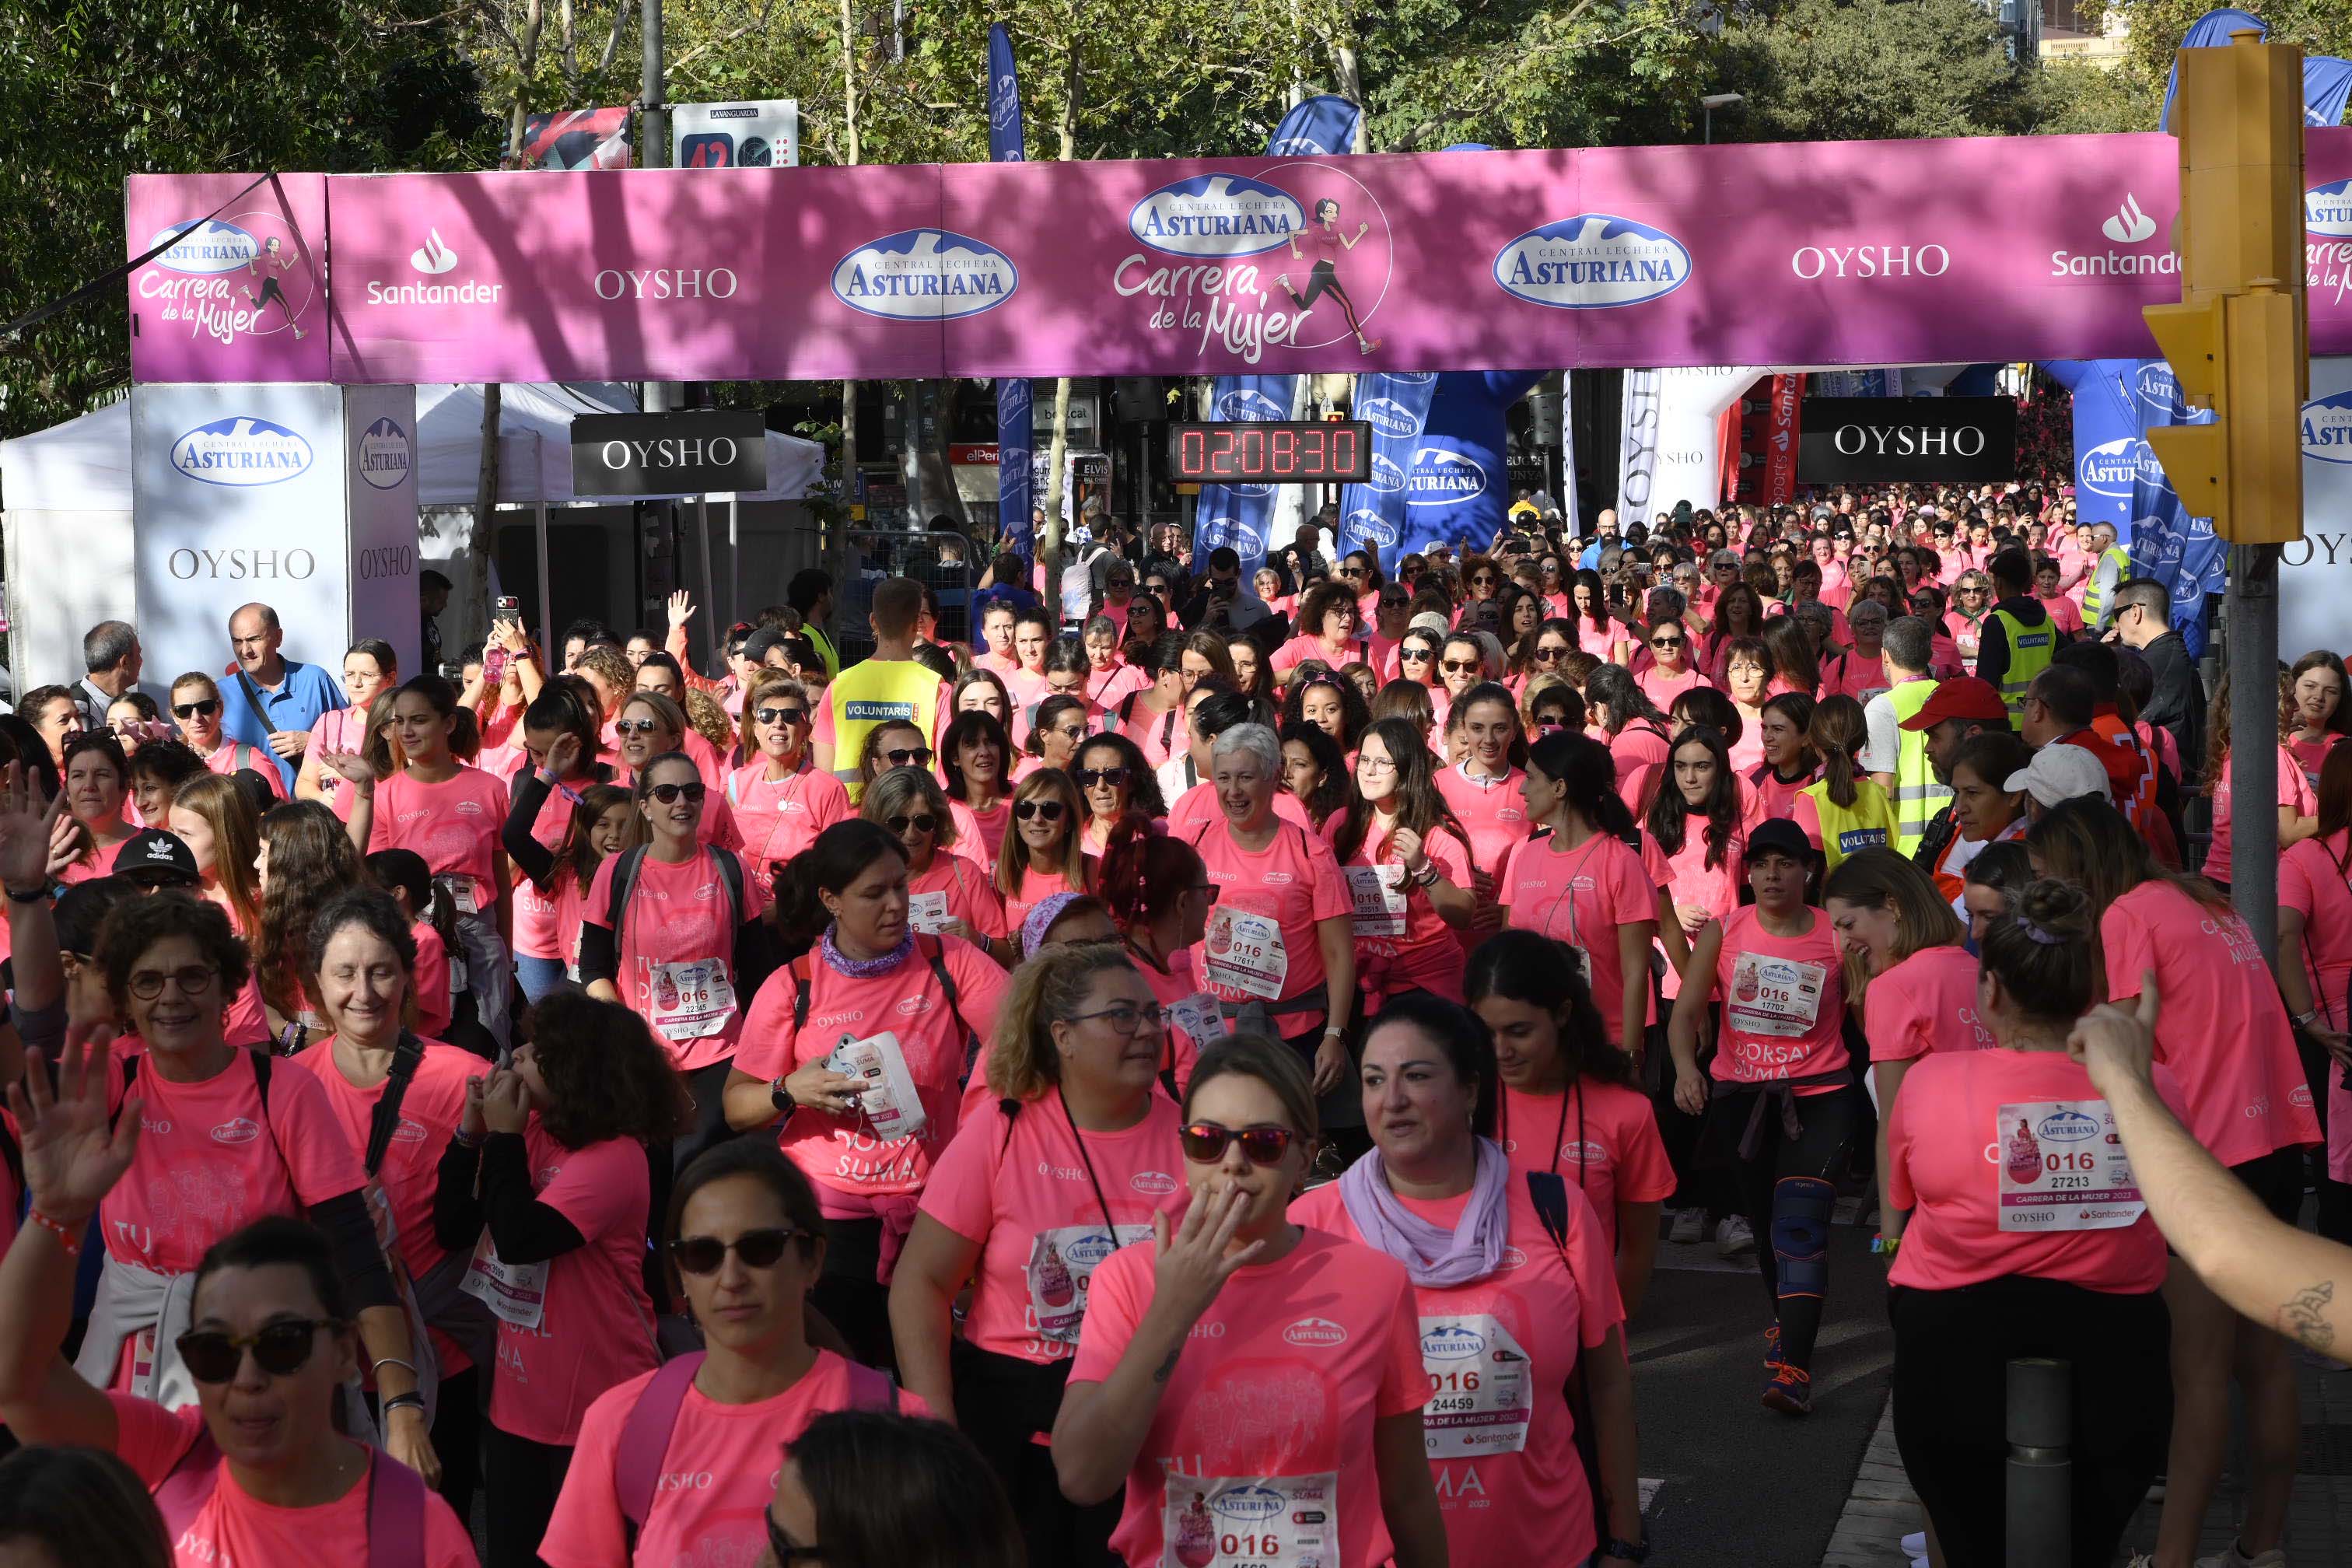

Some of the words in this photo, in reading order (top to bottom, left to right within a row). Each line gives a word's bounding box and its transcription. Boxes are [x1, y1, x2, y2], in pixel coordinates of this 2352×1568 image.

[1169, 202, 1225, 212] CENTRAL
[1229, 201, 1287, 210] LECHERA
[1143, 205, 1292, 236] ASTURIANA
[1538, 246, 1600, 257] CENTRAL
[1607, 245, 1668, 256] LECHERA
[874, 261, 933, 271] CENTRAL
[940, 259, 997, 269] LECHERA
[1509, 250, 1676, 285] ASTURIANA
[1792, 244, 1950, 279] OYSHO
[2052, 250, 2182, 276] Santand
[846, 263, 1004, 298] ASTURIANA
[1114, 254, 1259, 298] Carrera
[2323, 265, 2336, 287] la
[138, 269, 232, 300] Carrera
[366, 279, 502, 305] Santander
[594, 268, 737, 301] OYSHO
[161, 304, 179, 321] de
[181, 303, 195, 321] la
[192, 294, 265, 345] Mujer
[1150, 305, 1177, 330] de
[1182, 304, 1201, 330] la
[1198, 290, 1314, 364] Mujer
[1834, 425, 1985, 457] OYSHO
[182, 443, 303, 469] ASTURIANA
[362, 443, 408, 473] ASTURIANA
[602, 437, 737, 470] OYSHO
[1181, 430, 1355, 474] 02:08:30
[1084, 464, 1108, 474] ELVIS
[169, 548, 315, 579] OYSHO
[360, 544, 411, 579] OYSHO
[397, 809, 430, 822] OYSHO
[147, 852, 173, 861] adidas
[1357, 894, 1381, 904] 016
[1233, 942, 1262, 957] 016
[1233, 956, 1255, 967] 17611
[682, 990, 709, 1003] 016
[1760, 987, 1789, 1002] 016
[685, 1004, 707, 1013] 22345
[1762, 1002, 1785, 1011] 17702
[817, 1011, 863, 1027] OYSHO
[1734, 1017, 1761, 1027] OYSHO
[856, 1056, 874, 1066] SUMA
[1734, 1058, 1790, 1080] SUMA
[2042, 1125, 2095, 1136] ASTURIANA
[835, 1155, 917, 1181] SUMA
[2046, 1152, 2095, 1171] 016
[2051, 1177, 2090, 1188] 27213
[2012, 1212, 2056, 1223] OYSHO
[2091, 1209, 2137, 1220] Santander
[1286, 1327, 1346, 1343] ASTURIANA
[1422, 1340, 1481, 1353] ASTURIANA
[1428, 1371, 1481, 1392] 016
[1433, 1398, 1474, 1412] 24459
[1437, 1416, 1451, 1426] DE
[1465, 1415, 1496, 1423] MUJER
[1475, 1431, 1521, 1445] Santander
[1292, 1490, 1324, 1500] SUMA
[1220, 1533, 1279, 1556] 016
